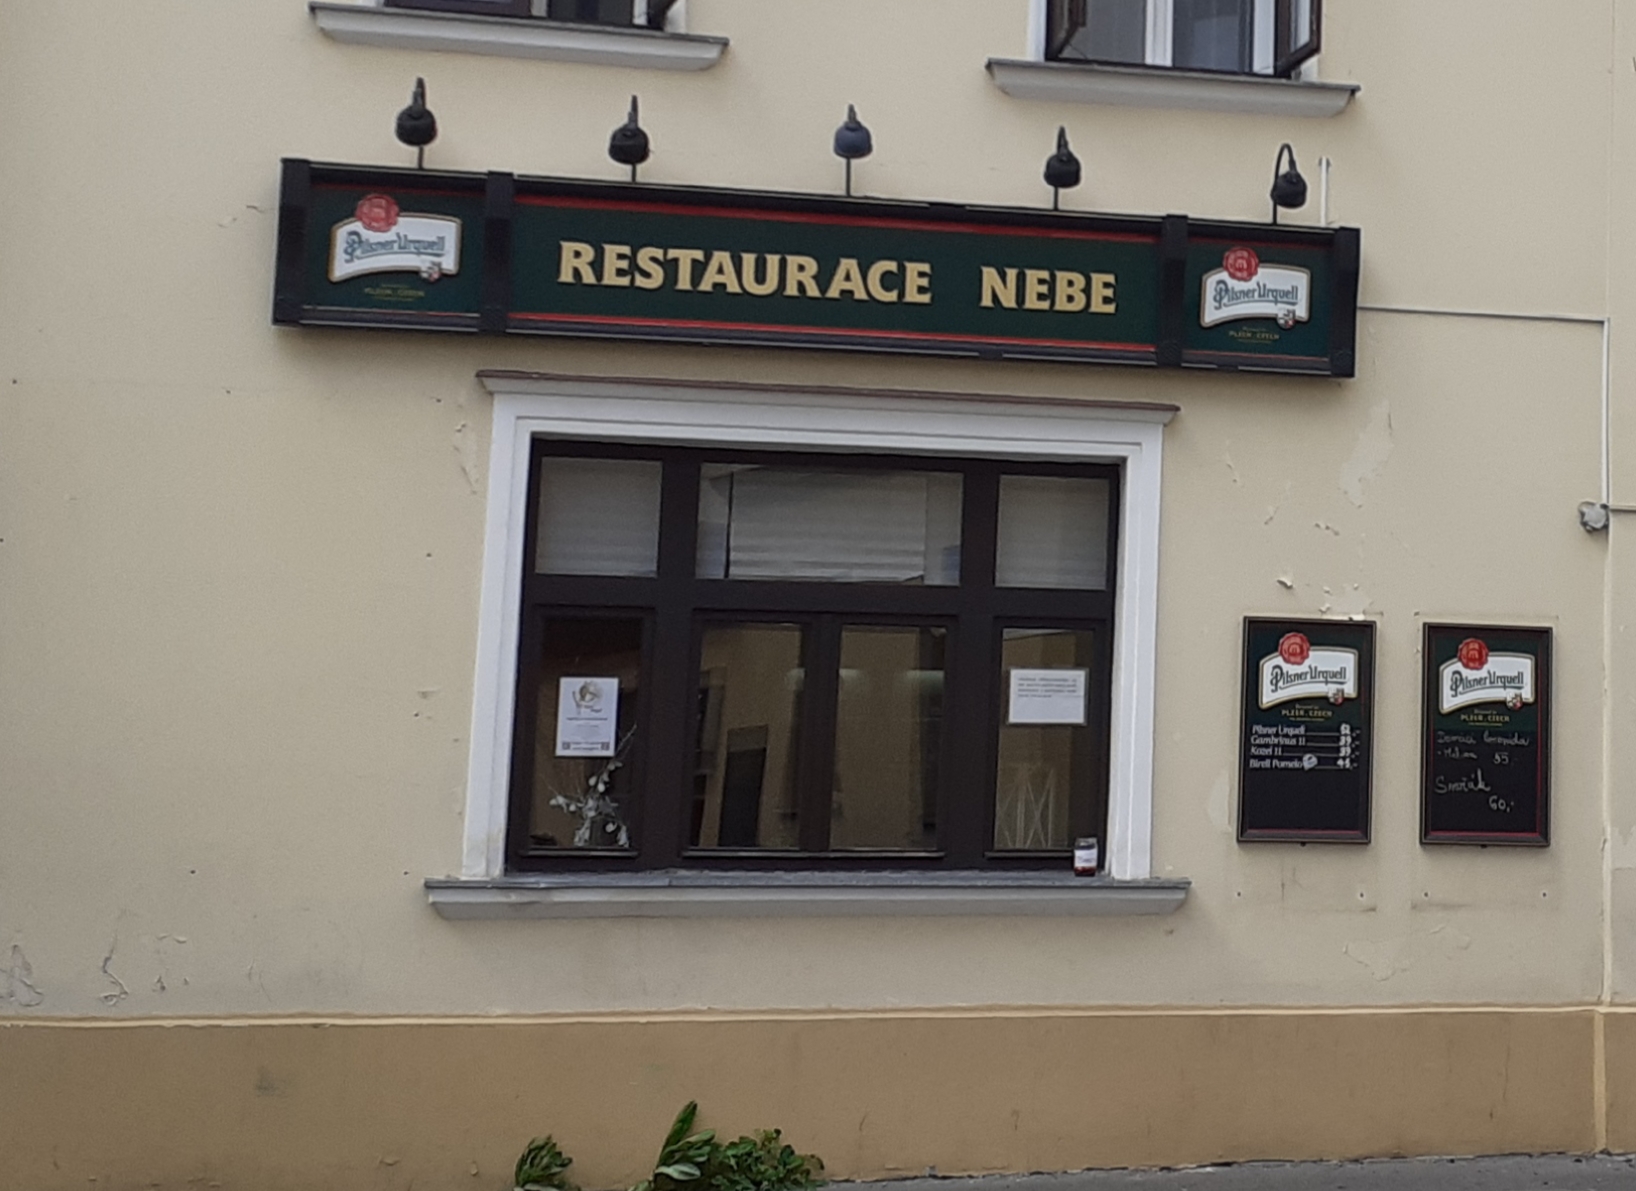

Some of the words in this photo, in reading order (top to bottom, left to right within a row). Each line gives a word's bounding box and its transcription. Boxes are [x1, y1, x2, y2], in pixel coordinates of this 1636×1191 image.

[557, 240, 932, 303] RESTAURACE
[979, 265, 1117, 314] NEBE
[1213, 280, 1257, 310] Pilsner
[1256, 281, 1299, 306] Urquell
[1270, 664, 1310, 693] Pilsner
[1308, 664, 1347, 686] Urquell
[1450, 670, 1488, 698] Pilsner
[1487, 670, 1524, 691] Urquell
